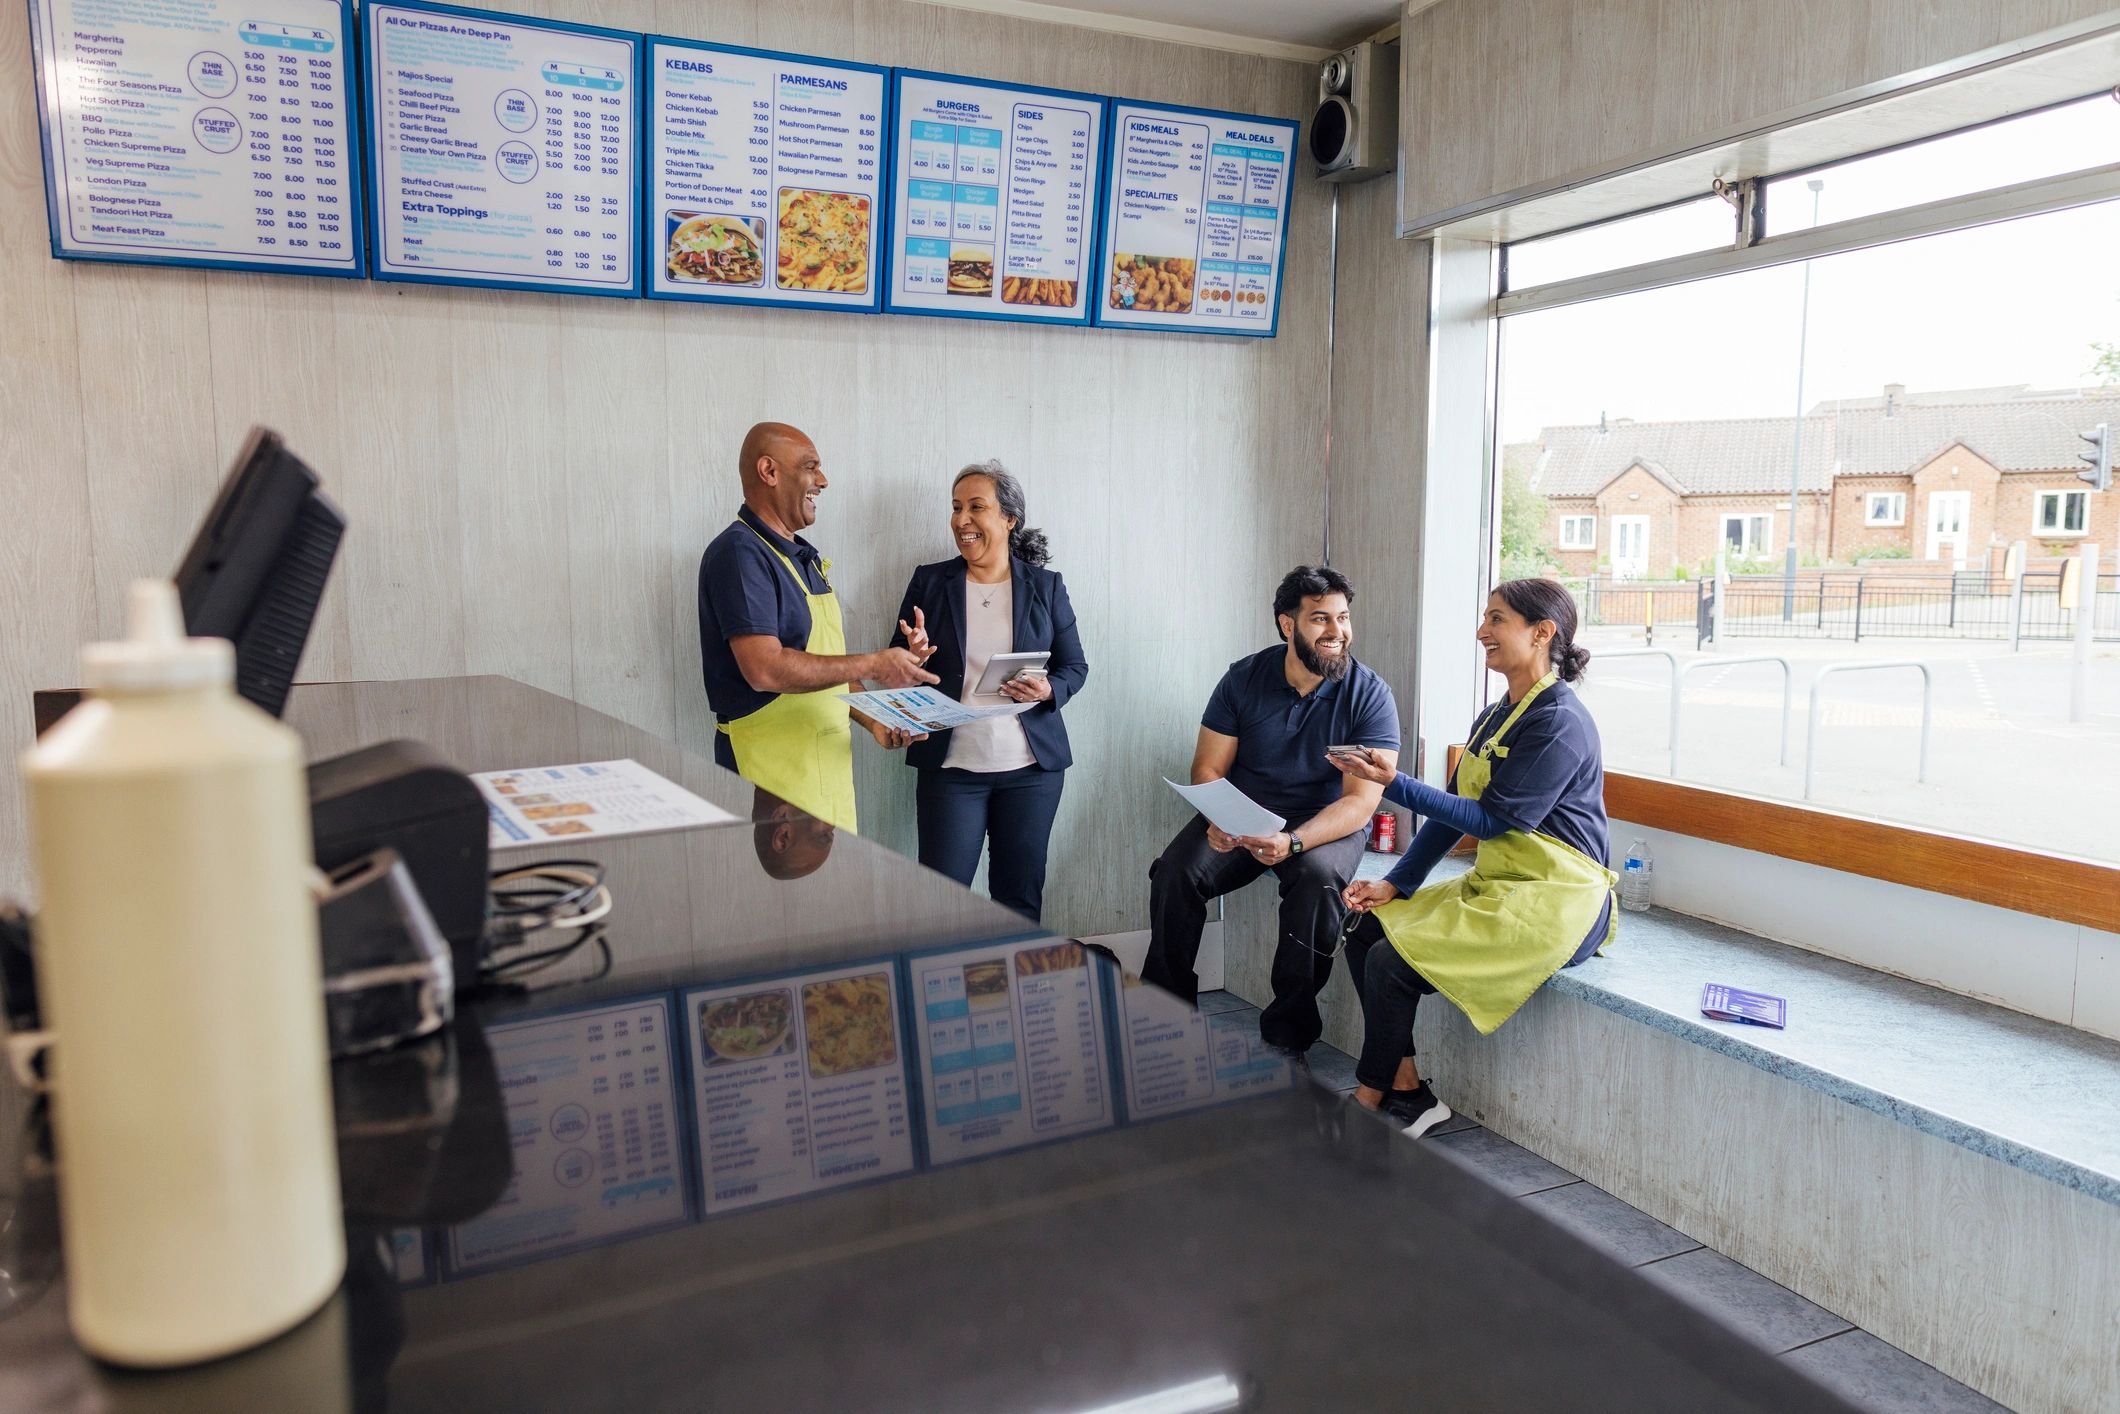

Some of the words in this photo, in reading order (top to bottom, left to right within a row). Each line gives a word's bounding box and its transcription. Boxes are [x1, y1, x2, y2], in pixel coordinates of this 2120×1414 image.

[248, 23, 257, 31] M
[282, 27, 289, 35] L
[312, 31, 325, 39] XL
[385, 16, 398, 25] All
[399, 18, 418, 28] Our
[419, 21, 449, 33] Pizzas
[450, 26, 467, 35] Are
[468, 28, 493, 40] Deep
[493, 32, 511, 41] Pan
[74, 32, 125, 44] Margherita
[75, 43, 123, 56] Pepperoni
[244, 51, 265, 60] 5.00
[278, 55, 297, 64] 7.00
[308, 59, 332, 68] 10.00
[202, 62, 222, 70] THIN
[202, 68, 223, 76] BASE
[245, 63, 266, 72] 6.50
[279, 67, 298, 76] 7.50
[310, 71, 331, 80] 11.00
[666, 59, 713, 74] KEBABS
[424, 74, 453, 84] Special
[605, 71, 616, 79] XL
[120, 80, 158, 91] Seasons
[158, 84, 182, 94] Pizza
[781, 74, 848, 91] PARMESANS
[398, 88, 433, 99] Seafood
[434, 93, 454, 102] Pizza
[666, 90, 688, 99] Doner
[689, 93, 713, 102] Kebab
[98, 97, 120, 106] Shot
[121, 99, 145, 108] Pizza
[422, 102, 441, 111] Beef
[440, 105, 460, 114] Pizza
[753, 101, 770, 109] 5.50
[937, 100, 980, 113] BURGERS
[507, 105, 525, 113] BASE
[665, 103, 695, 113] Chicken
[695, 107, 719, 116] Kebab
[779, 104, 807, 113] Chicken
[808, 107, 841, 117] Parmesan
[82, 114, 103, 123] BBQ
[399, 111, 424, 120] Doner
[425, 114, 446, 123] Pizza
[665, 116, 687, 125] Lamb
[687, 118, 707, 127] Shish
[753, 113, 769, 121] 7.00
[859, 113, 876, 122] 8.00
[1018, 110, 1043, 121] SIDES
[198, 118, 236, 128] STUFFED
[399, 122, 423, 132] Garlic
[424, 125, 448, 135] Bread
[779, 119, 815, 130] Mushroom
[816, 124, 850, 134] Parmesan
[1017, 123, 1033, 131] Chips
[109, 128, 132, 138] Pizza
[204, 125, 231, 134] CRUST
[665, 128, 691, 138] Double
[1130, 123, 1153, 132] KIDS
[1153, 125, 1179, 136] MEALS
[400, 134, 429, 145] Cheesy
[431, 137, 453, 146] Garlic
[455, 140, 478, 149] Bread
[749, 138, 769, 146] 10.00
[793, 136, 809, 144] Shot
[809, 138, 843, 148] Parmesan
[1033, 137, 1049, 145] Chips
[1226, 131, 1248, 141] MEAL
[1249, 134, 1274, 144] DEALS
[84, 138, 120, 148] Chicken
[121, 142, 162, 152] Supreme
[163, 145, 186, 154] Pizza
[665, 147, 686, 156] Triple
[687, 149, 700, 157] Mix
[400, 145, 427, 154] Create
[428, 148, 449, 156] Your
[448, 150, 466, 158] Own
[466, 152, 487, 161] Pizza
[501, 151, 533, 160] STUFFED
[778, 150, 808, 159] Hawaiian
[809, 153, 843, 163] Parmesan
[85, 157, 104, 167] Veg
[105, 159, 146, 169] Supreme
[147, 162, 170, 171] Pizza
[506, 157, 529, 165] CRUST
[665, 159, 694, 168] Chicken
[695, 162, 714, 171] Tikka
[665, 168, 702, 178] Shawarma
[778, 165, 814, 175] Bolognese
[815, 169, 848, 178] Parmesan
[87, 176, 122, 185] London
[123, 179, 147, 187] Pizza
[401, 177, 430, 186] Stuffed
[429, 180, 454, 189] Crust
[665, 180, 692, 189] Portion
[702, 184, 724, 192] Doner
[725, 186, 743, 194] Meat
[1030, 178, 1046, 186] Rings
[402, 188, 423, 197] Extra
[424, 190, 453, 200] Cheese
[546, 192, 563, 200] 2.00
[574, 195, 591, 203] 2.50
[602, 197, 618, 205] 3.50
[750, 189, 768, 197] 4.00
[1125, 189, 1178, 202] SPECIALITIES
[89, 194, 137, 205] Bolognese
[138, 198, 161, 207] Pizza
[665, 193, 687, 201] Doner
[688, 195, 707, 203] Meat
[714, 197, 734, 206] Chips
[90, 206, 131, 216] Tandoori
[131, 209, 148, 217] Hot
[149, 211, 173, 219] Pizza
[402, 201, 434, 213] Extra
[436, 204, 488, 220] Toppings
[402, 214, 418, 224] Veg
[92, 224, 115, 233] Meat
[116, 226, 141, 235] Feast
[142, 228, 165, 237] Pizza
[403, 237, 423, 245] Meat
